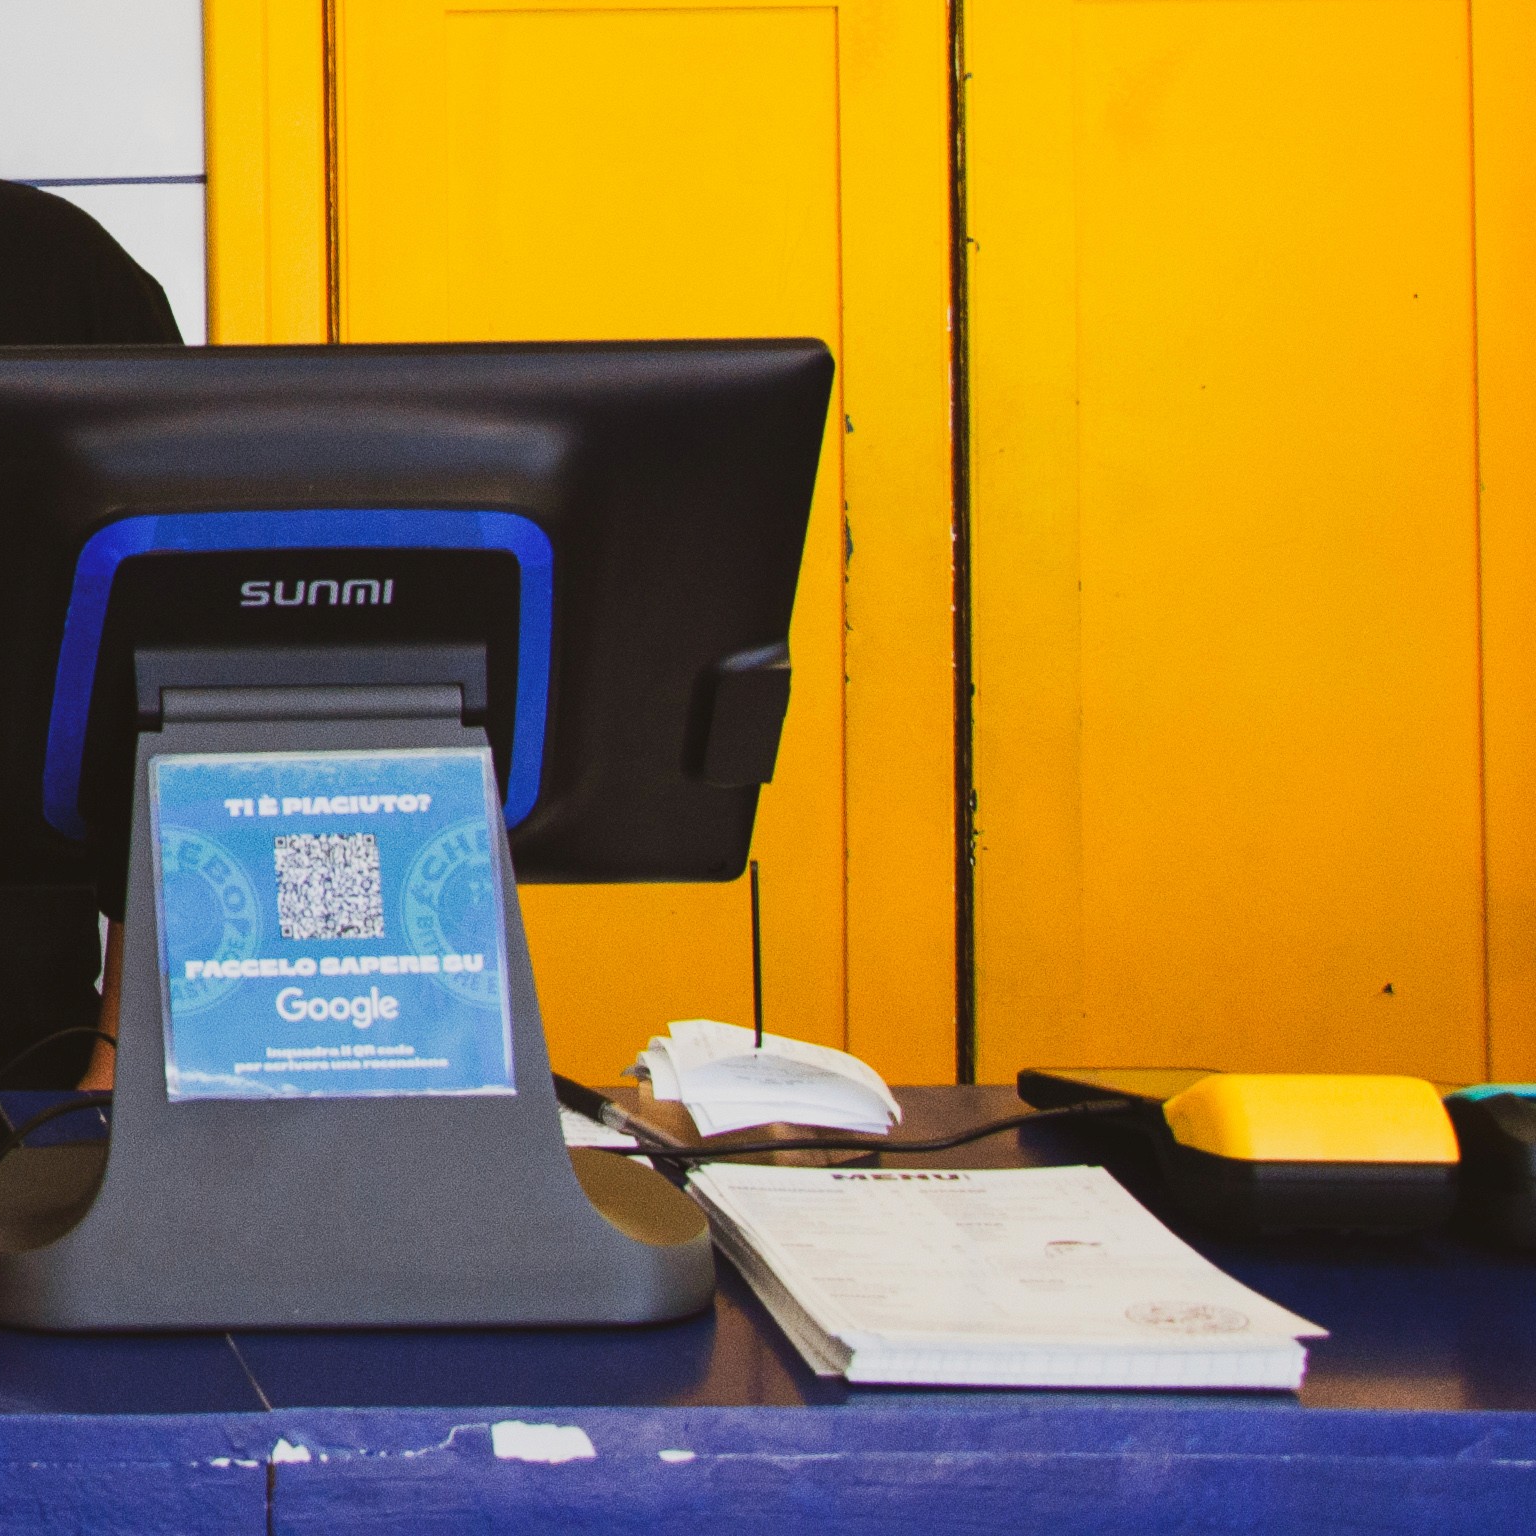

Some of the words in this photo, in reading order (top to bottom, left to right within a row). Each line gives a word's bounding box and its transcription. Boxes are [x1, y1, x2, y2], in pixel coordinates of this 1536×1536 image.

[224, 798, 254, 817] TI
[282, 794, 432, 815] PIACIUTO?
[185, 958, 317, 979] FACCELO
[319, 955, 439, 975] SAPERE
[442, 953, 484, 972] SU
[276, 986, 399, 1029] Google
